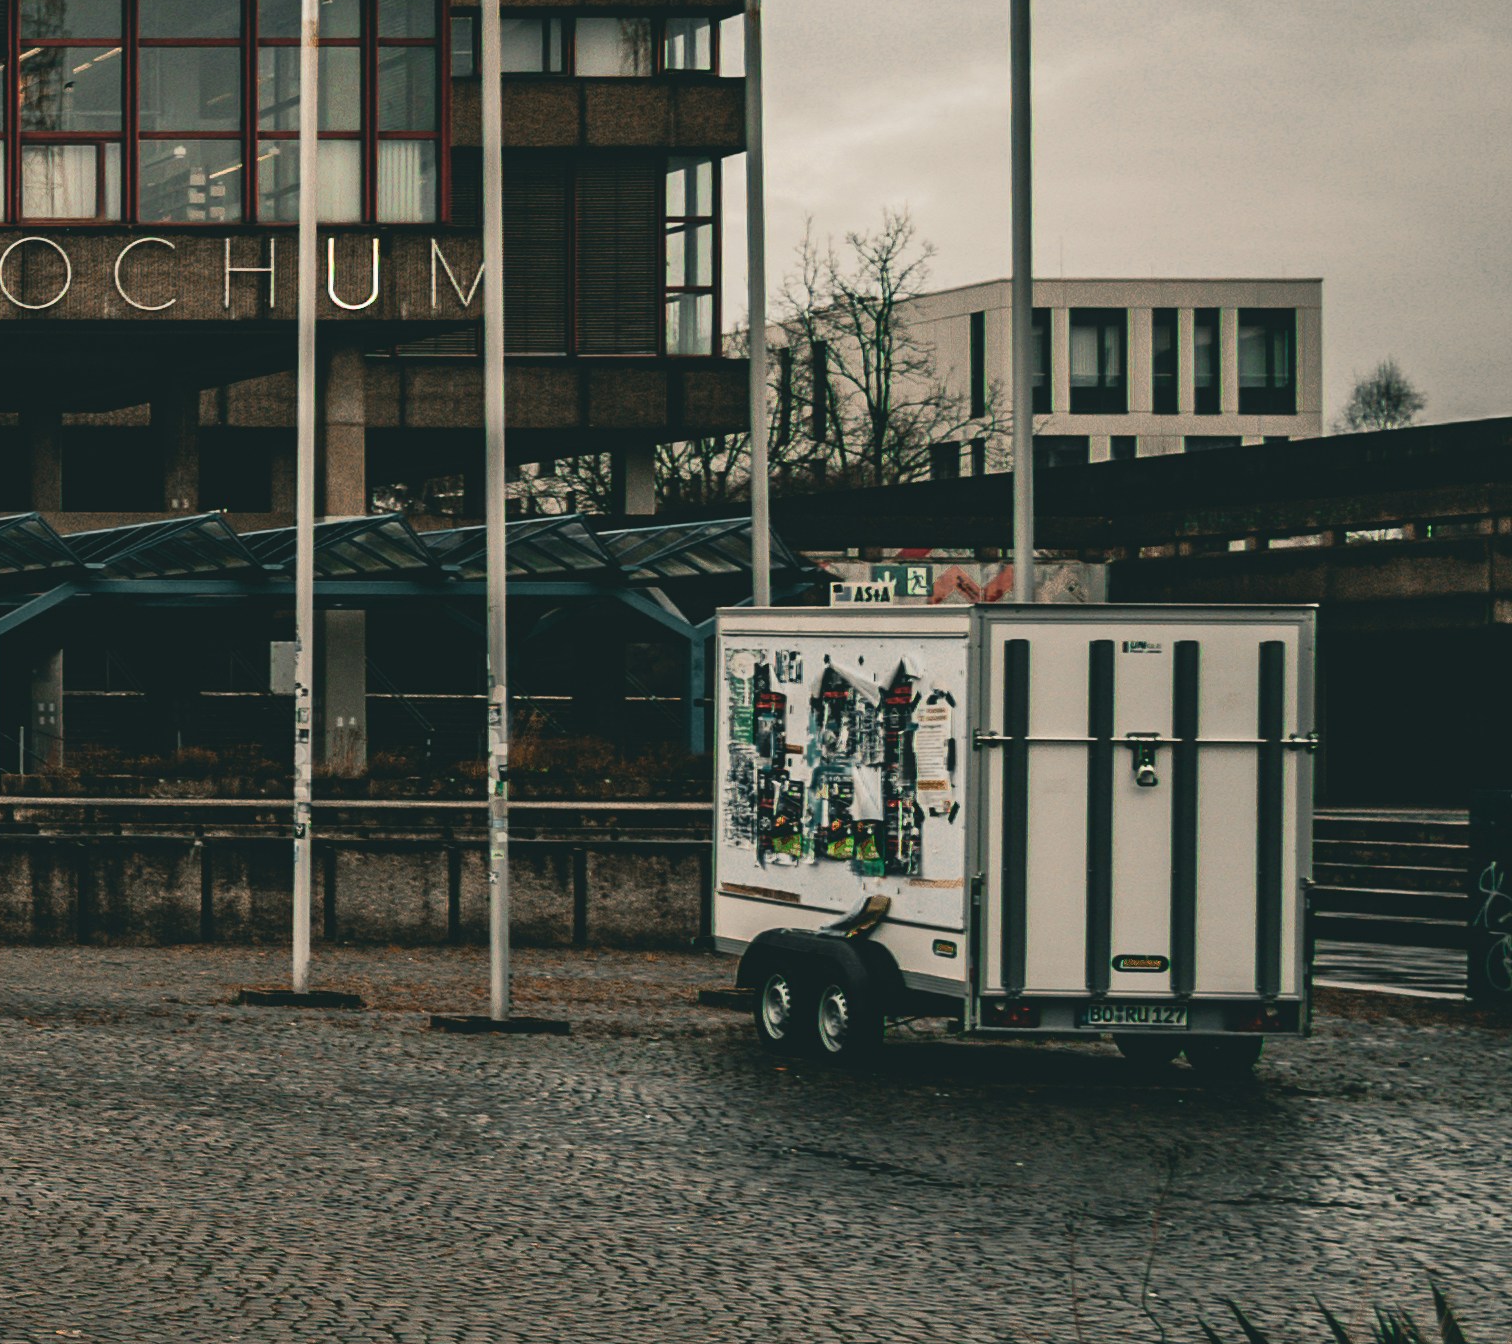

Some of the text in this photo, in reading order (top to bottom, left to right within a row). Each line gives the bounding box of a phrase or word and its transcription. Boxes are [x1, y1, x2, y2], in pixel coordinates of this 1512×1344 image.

[1089, 1005, 1186, 1024] BO RU 127
